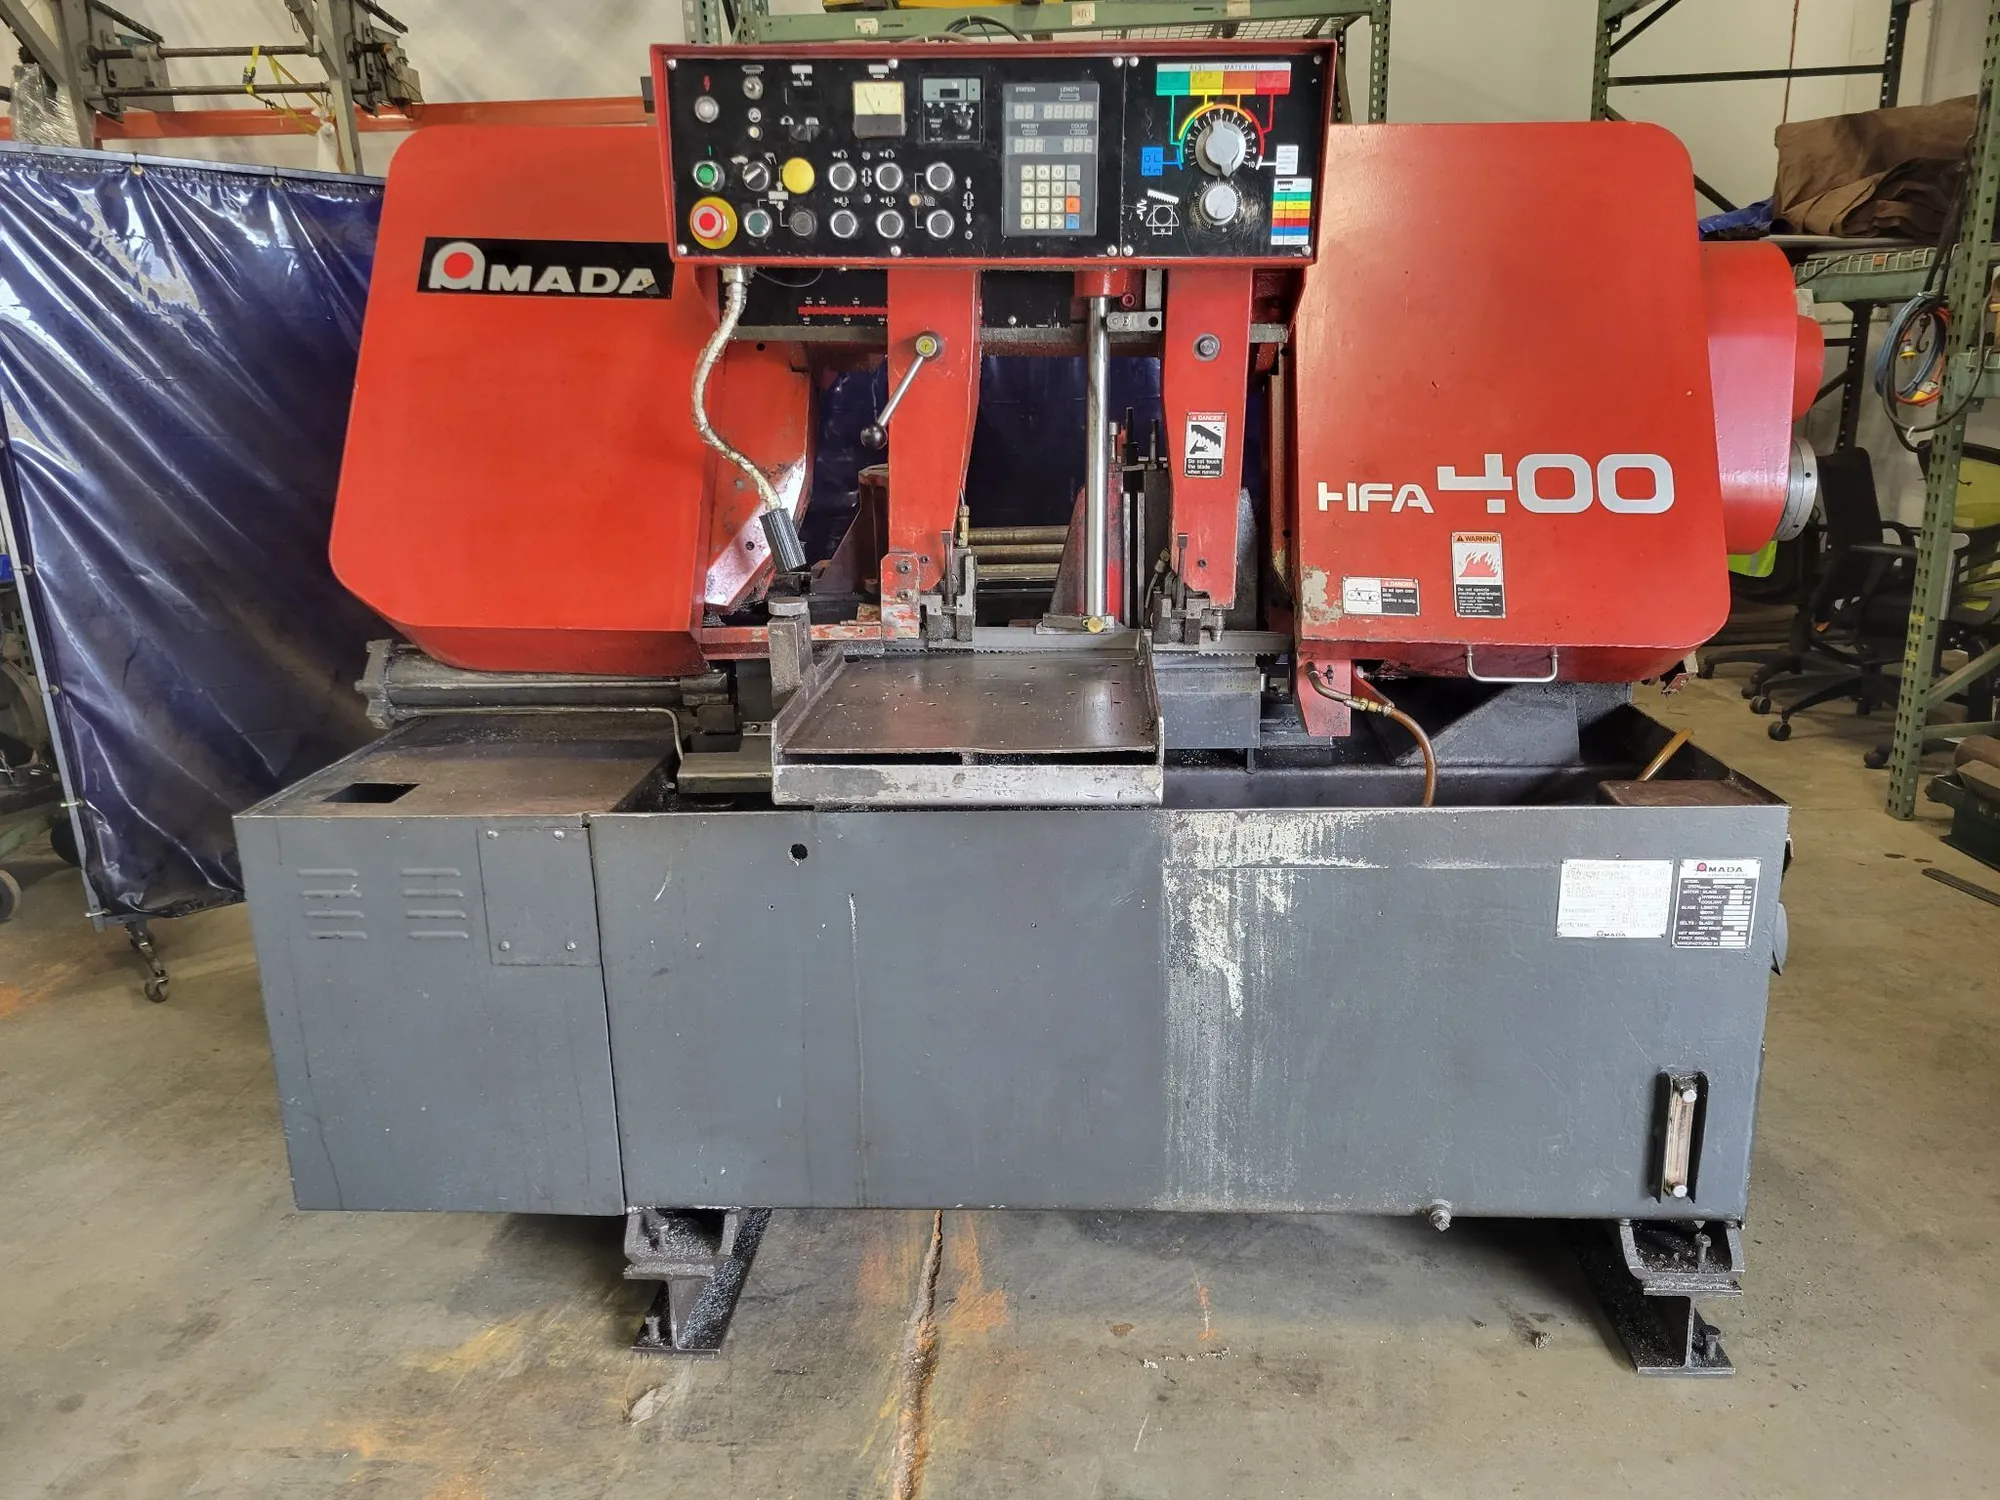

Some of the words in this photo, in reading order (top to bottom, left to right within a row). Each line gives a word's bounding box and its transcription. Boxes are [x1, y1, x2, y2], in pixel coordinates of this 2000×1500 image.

[428, 241, 660, 294] AMADA
[1317, 482, 1434, 513] HFA
[1437, 453, 1675, 513] 400
[1696, 862, 1743, 873] AMADA
